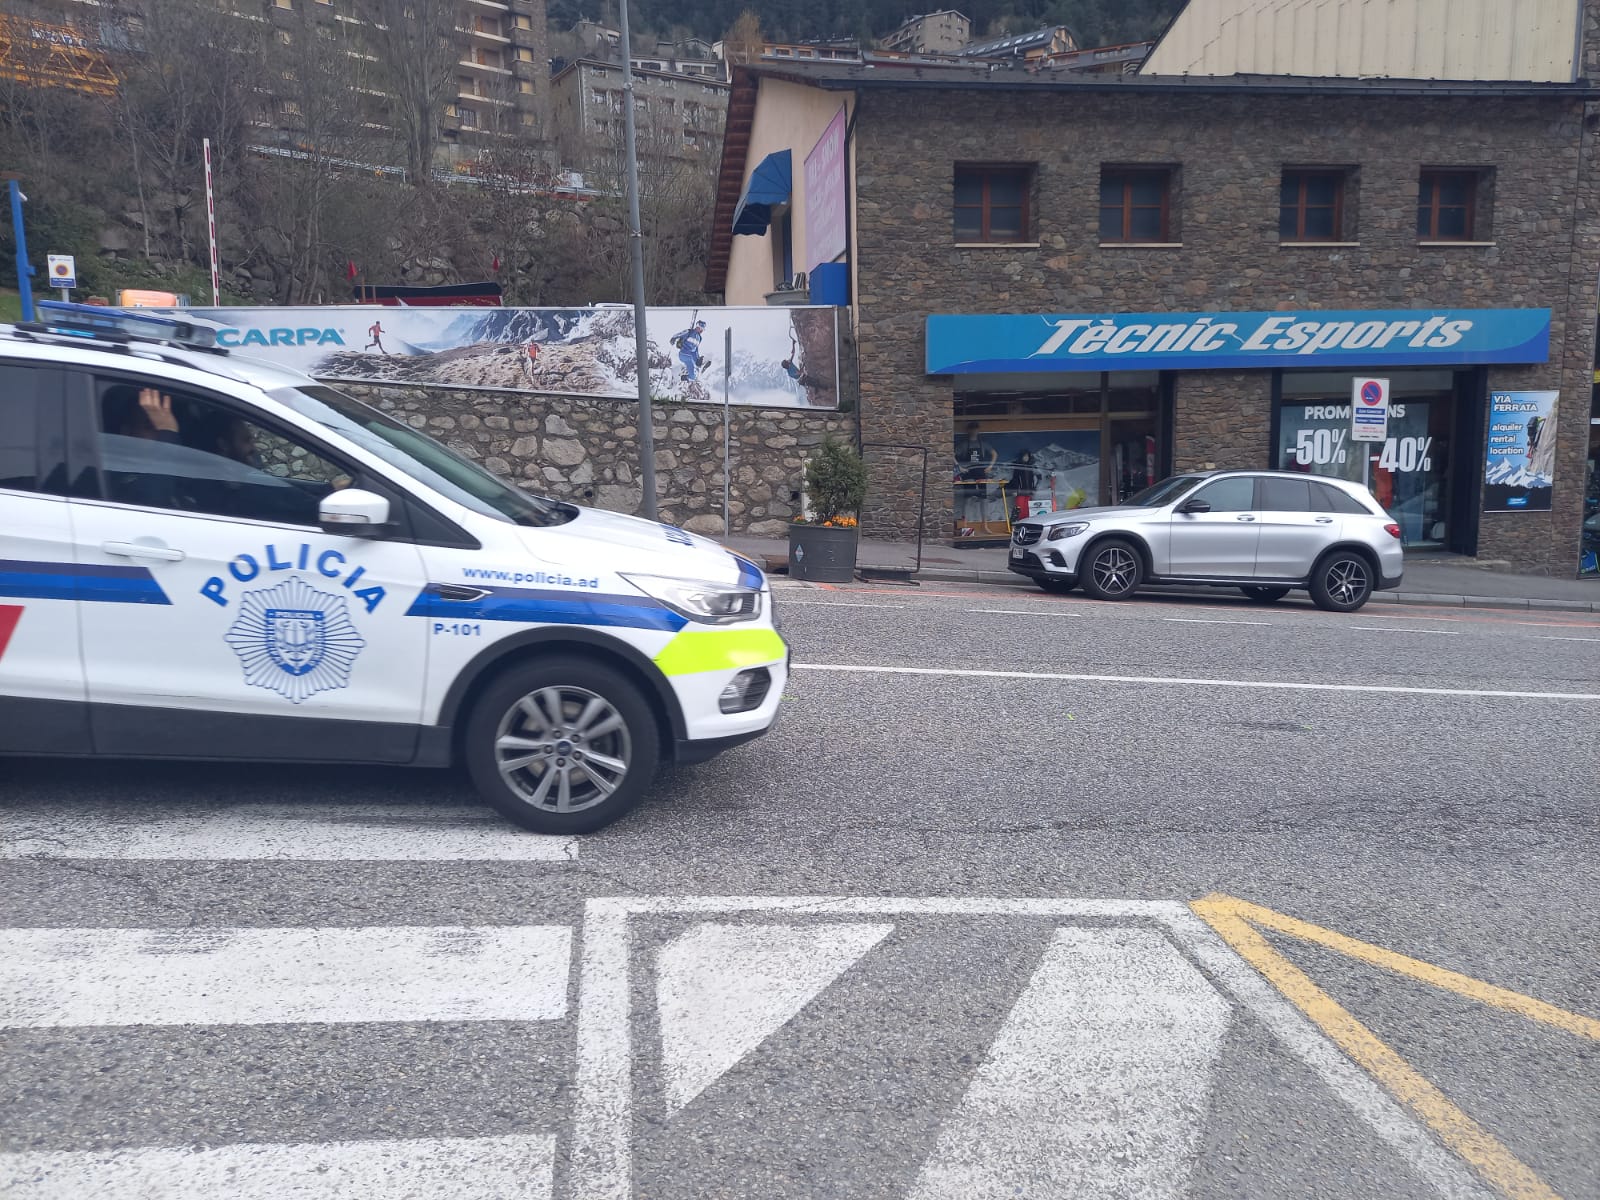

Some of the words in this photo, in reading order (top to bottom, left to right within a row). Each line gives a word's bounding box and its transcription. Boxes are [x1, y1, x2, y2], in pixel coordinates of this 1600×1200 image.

[1035, 317, 1238, 356] Tècnic
[1240, 316, 1473, 355] Esports
[1494, 395, 1512, 403] VIA
[1493, 404, 1538, 412] FERRATA
[1492, 423, 1522, 432] alquiler
[1490, 435, 1516, 443] rental
[1286, 428, 1347, 465] -50%
[1489, 447, 1524, 455] location
[1369, 436, 1433, 473] -40%
[200, 543, 386, 615] POLICIA
[462, 566, 599, 590] www.policia.ad
[434, 623, 482, 637] P-101
